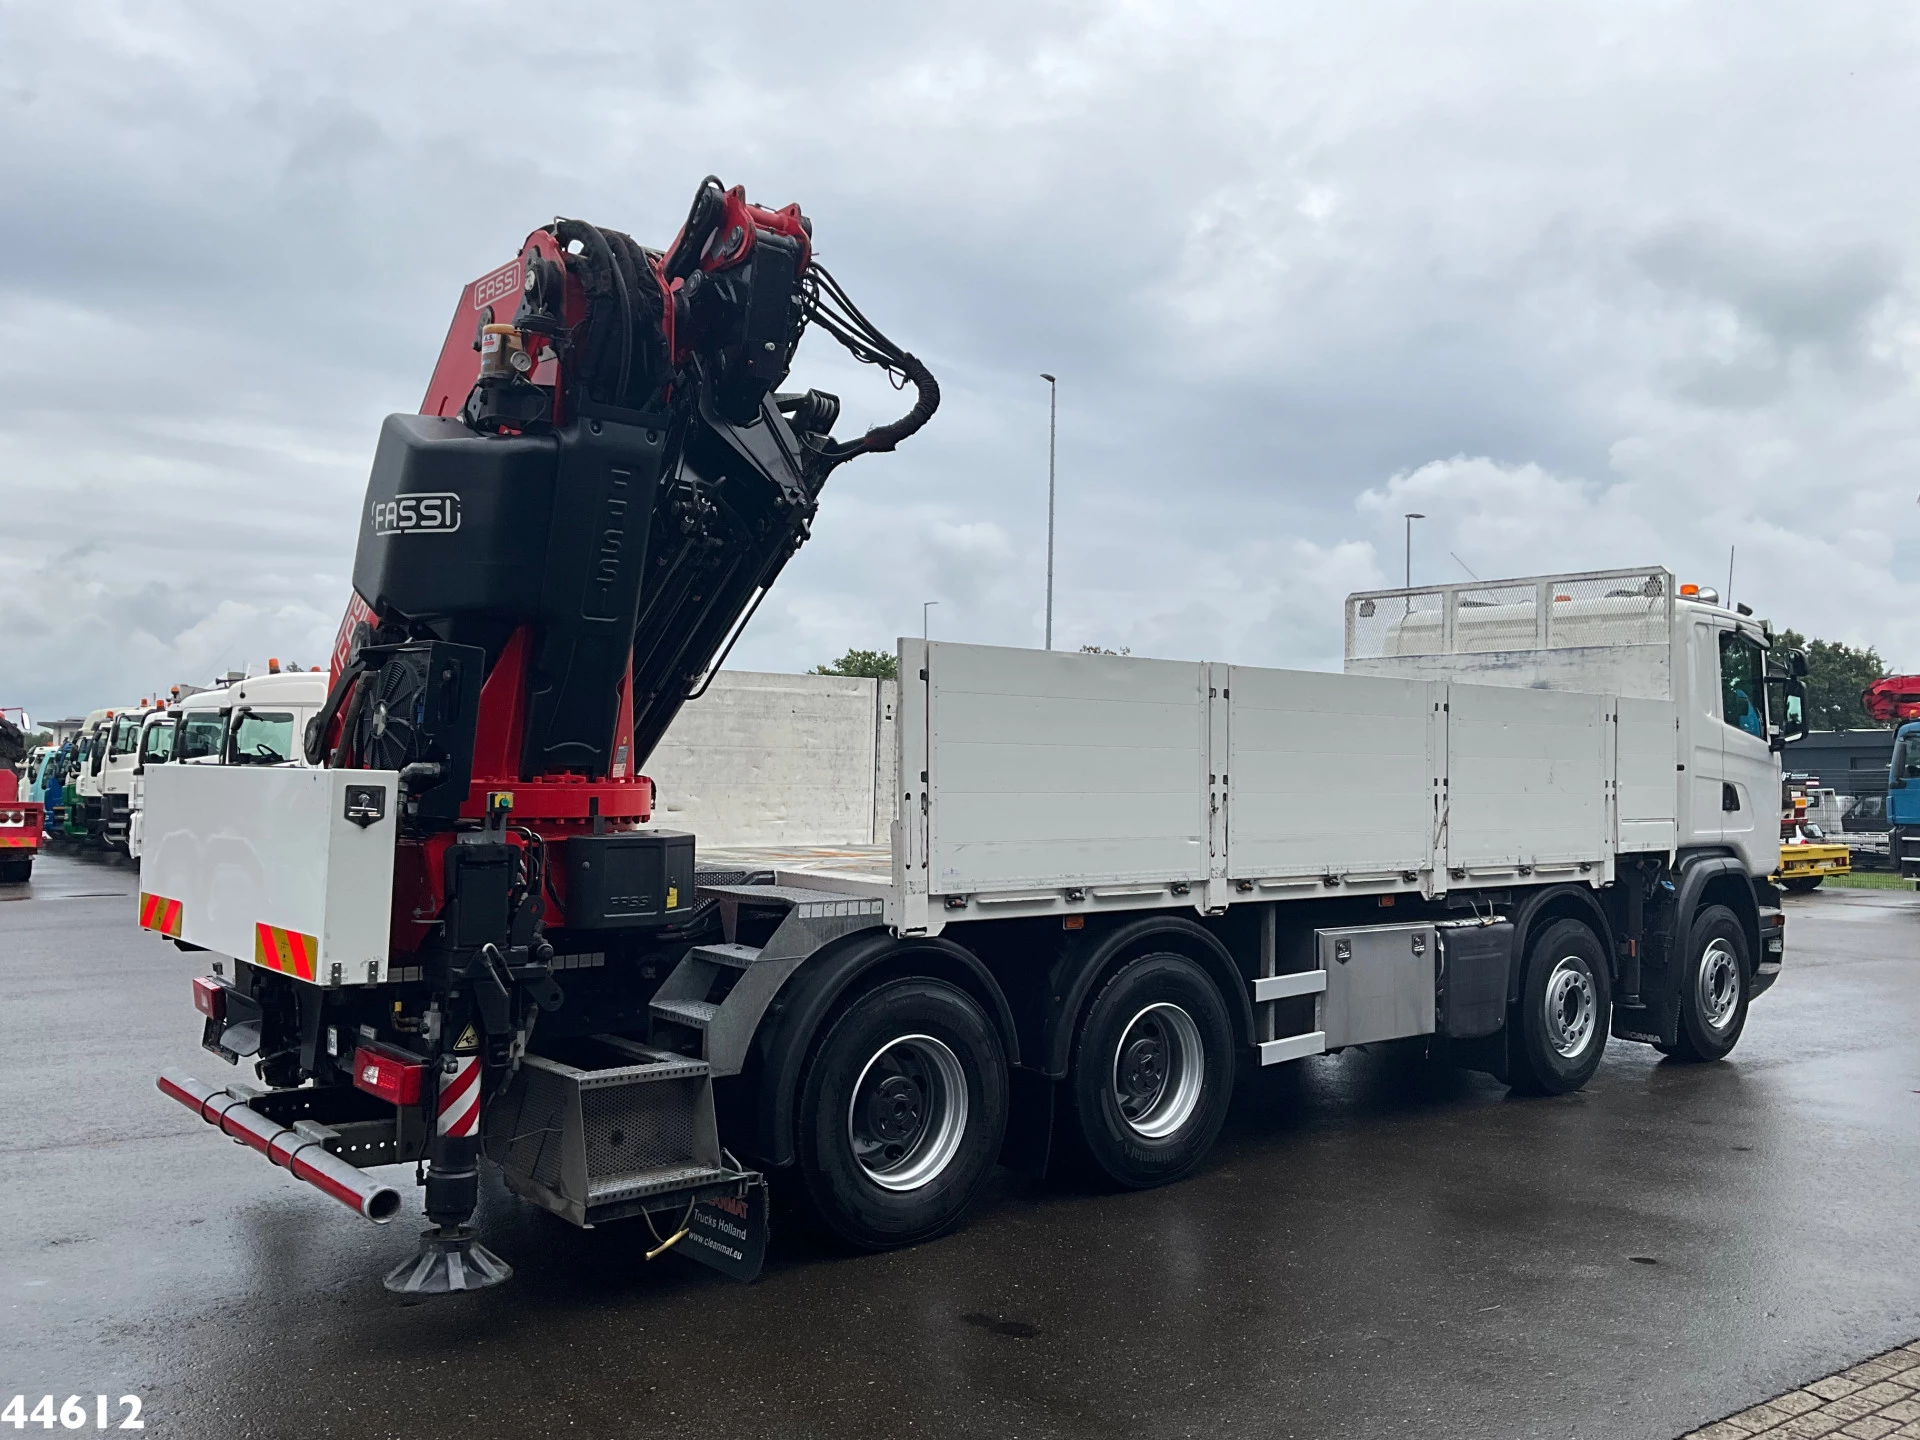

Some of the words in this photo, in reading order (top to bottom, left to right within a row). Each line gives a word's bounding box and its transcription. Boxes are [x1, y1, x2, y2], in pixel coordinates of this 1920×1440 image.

[478, 268, 517, 304] FASSI
[375, 499, 451, 530] FASSI
[336, 592, 368, 670] FAS
[694, 1208, 717, 1228] Trucks
[717, 1218, 747, 1241] Holland
[688, 1231, 743, 1260] www.cleanmat.eu
